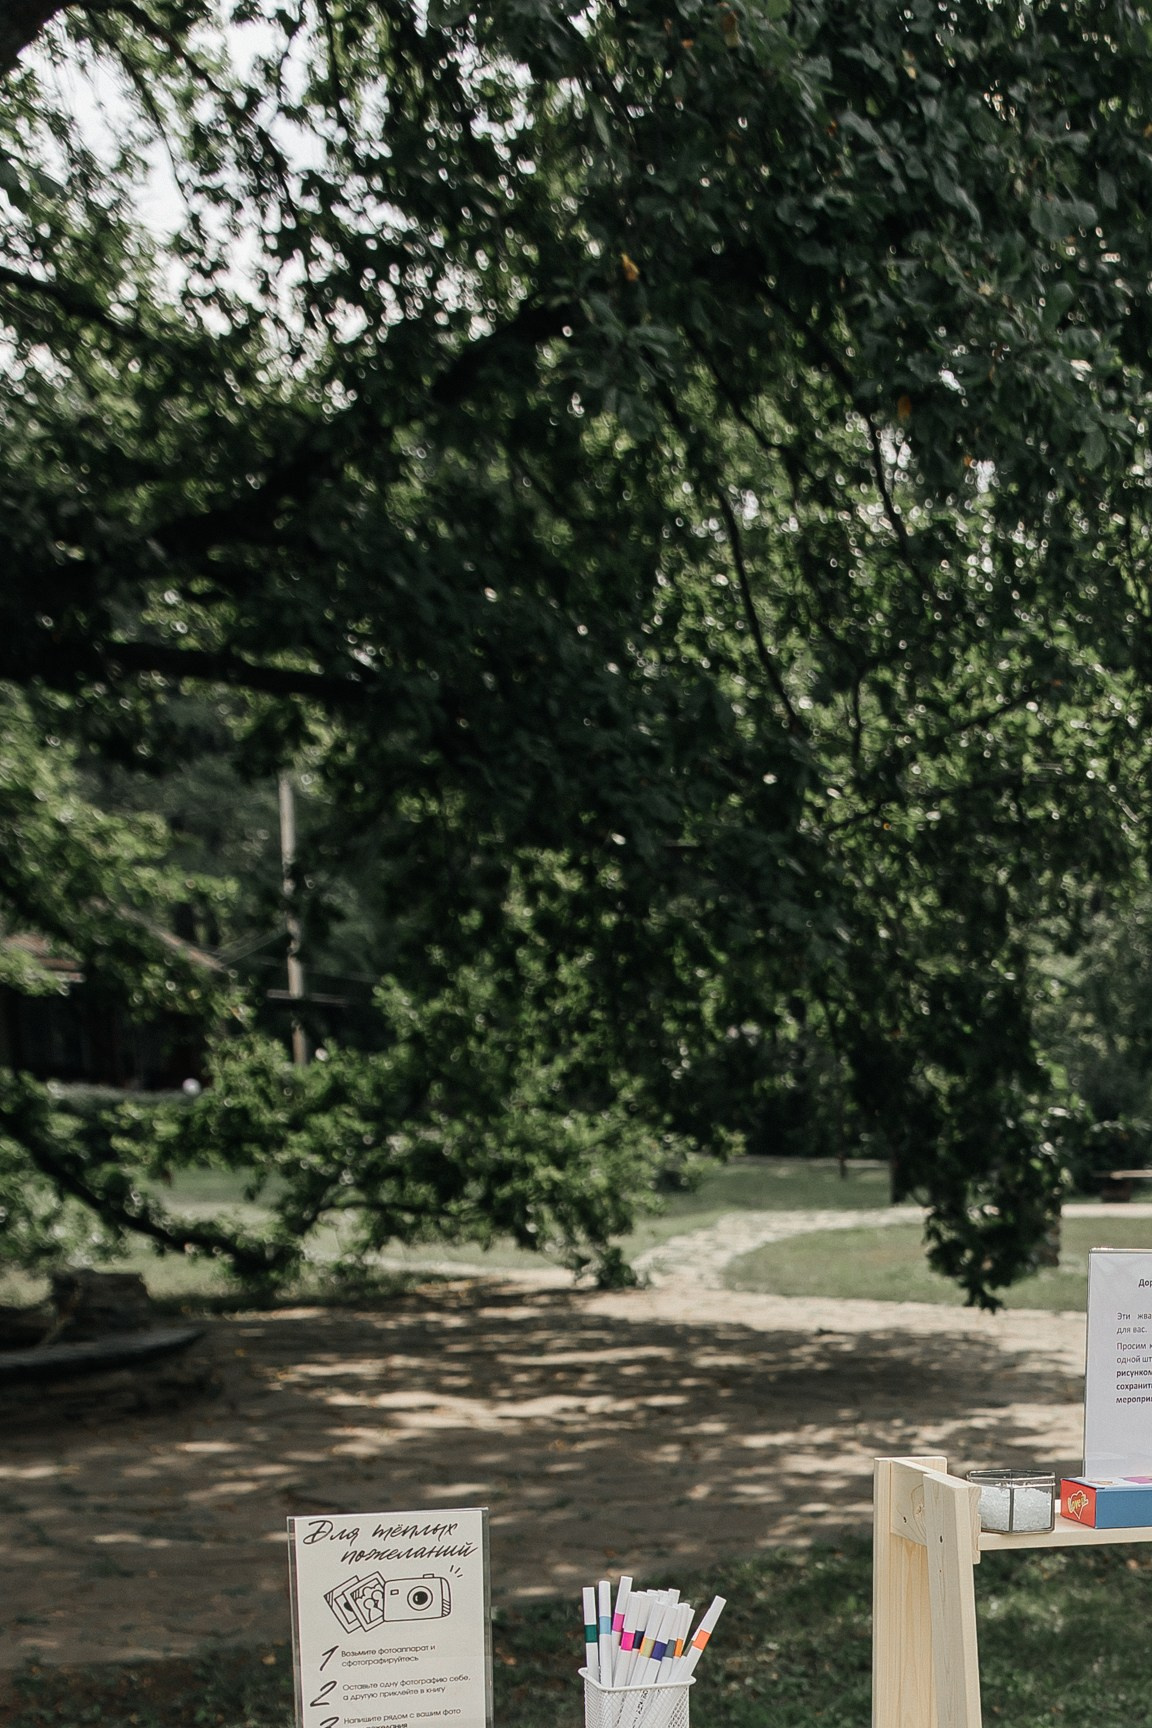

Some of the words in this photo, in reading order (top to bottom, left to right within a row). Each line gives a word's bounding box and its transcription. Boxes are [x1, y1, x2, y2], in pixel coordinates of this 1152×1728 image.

[1117, 1312, 1130, 1320] Эти
[1117, 1342, 1146, 1351] Просим
[1117, 1356, 1140, 1364] одной
[303, 1520, 360, 1546] Для
[372, 1522, 458, 1541] тёплых
[341, 1542, 478, 1564] пожеланий
[320, 1645, 339, 1671] 1
[341, 1649, 376, 1658] Возьмите
[378, 1645, 429, 1656] фотоаппарат
[342, 1656, 419, 1668] сфотографируйтесь
[400, 1677, 447, 1687] фотографию
[310, 1681, 337, 1707] 2
[350, 1692, 378, 1701] другую
[380, 1689, 418, 1698] приклейте
[426, 1687, 445, 1695] книгу
[344, 1715, 381, 1724] Напишите
[383, 1713, 408, 1722] рядом
[443, 1708, 461, 1717] фото
